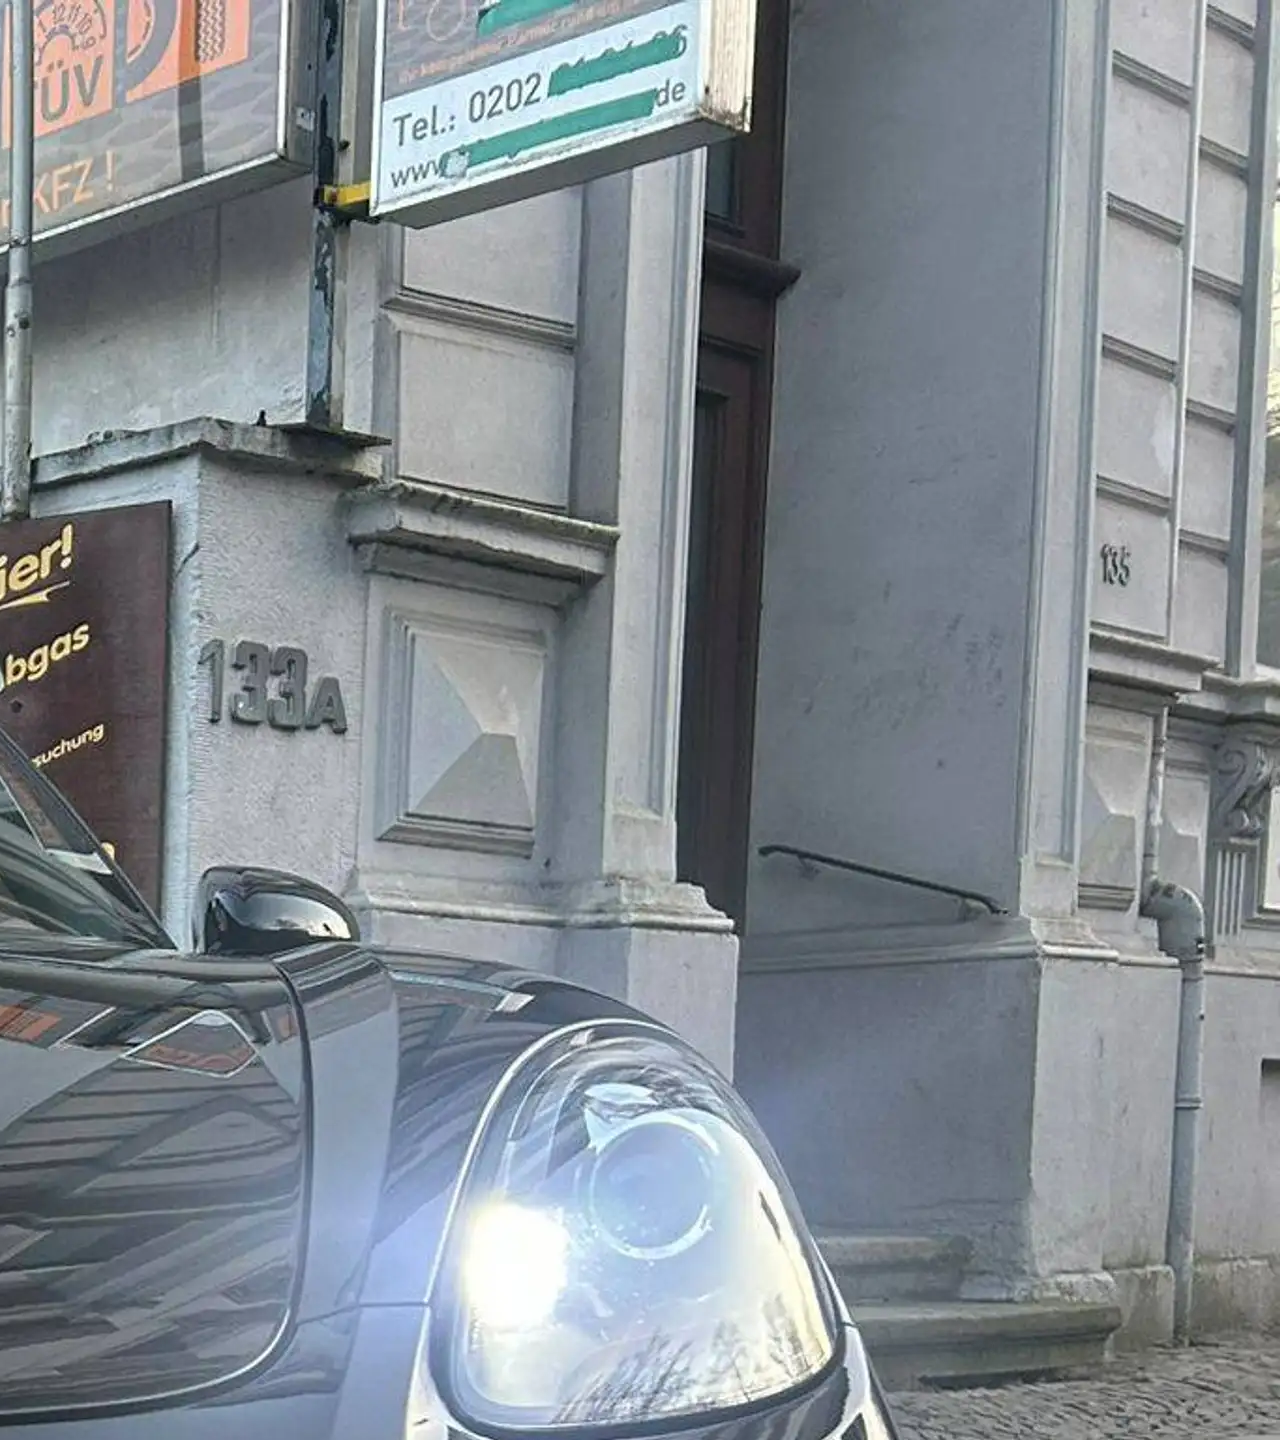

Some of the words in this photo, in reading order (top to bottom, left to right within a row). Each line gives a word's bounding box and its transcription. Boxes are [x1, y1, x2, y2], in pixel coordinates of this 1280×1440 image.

[34, 54, 104, 122] ÜV
[393, 105, 456, 147] Tel.:
[468, 72, 541, 123] 0202
[106, 151, 116, 192] !
[197, 638, 349, 735] 133A
